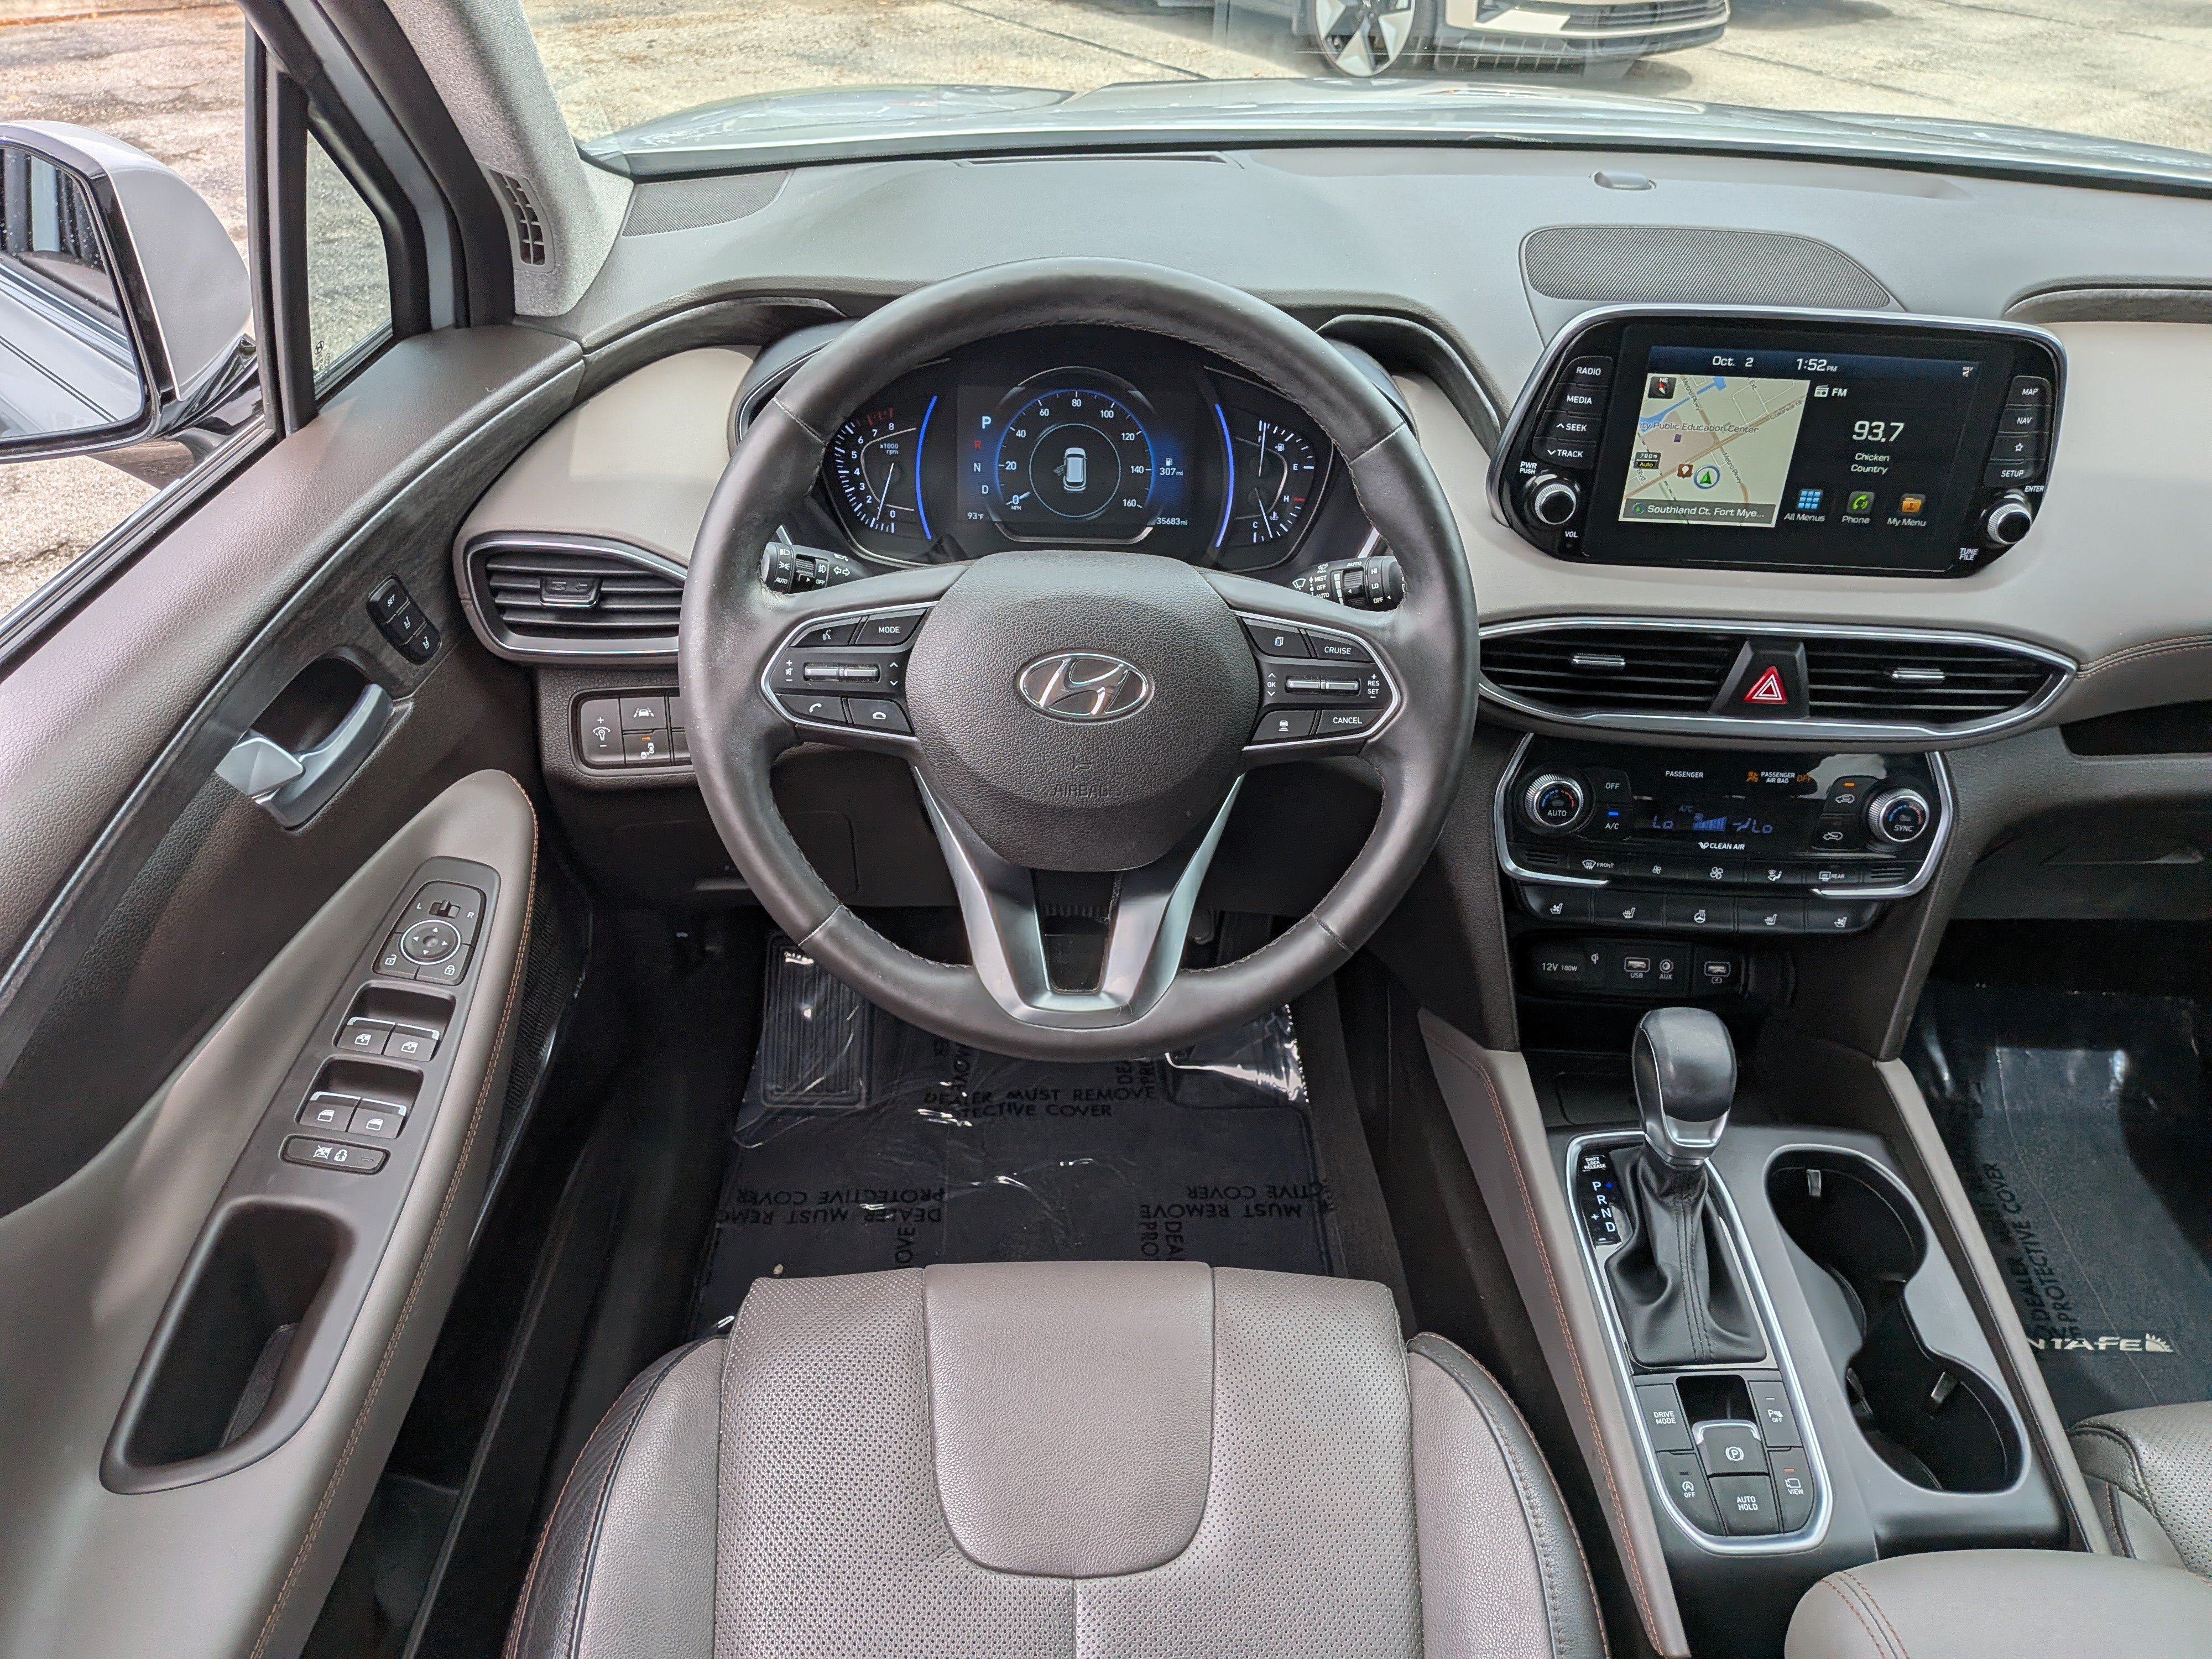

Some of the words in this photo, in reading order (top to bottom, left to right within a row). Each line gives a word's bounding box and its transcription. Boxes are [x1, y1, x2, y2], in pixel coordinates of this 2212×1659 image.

[1712, 356, 1735, 366] Oct.
[1745, 357, 1754, 367] 2
[1576, 367, 1601, 376] RADIO
[1832, 388, 1848, 397] FM
[1072, 399, 1082, 407] 80
[1566, 395, 1592, 404] MEDIA
[1039, 408, 1050, 416] 60
[1100, 410, 1114, 418] 100
[888, 422, 894, 431] 8
[982, 416, 992, 429] P
[1566, 423, 1587, 432] SEEK
[1682, 423, 1726, 432] Education
[1728, 425, 1759, 433] Center
[1852, 421, 1905, 442] 93.7
[872, 429, 878, 437] 7
[1015, 430, 1026, 438] 40
[1121, 432, 1135, 441] 120
[858, 436, 864, 444] 6
[974, 440, 981, 450] R
[851, 451, 857, 459] 5
[1557, 450, 1583, 458] TRACK
[1855, 452, 1890, 462] Chicken
[973, 462, 981, 472] N
[1005, 461, 1017, 470] 20
[1520, 461, 1537, 469] PWR
[1723, 452, 1734, 469] Metro
[1732, 469, 1743, 483] Pkwy
[1851, 464, 1888, 474] Country
[854, 468, 860, 476] 4
[1130, 466, 1144, 474] 140
[859, 482, 865, 491] 3
[982, 485, 989, 494] D
[866, 495, 872, 503] 2
[1012, 494, 1019, 504] 0
[1123, 499, 1136, 507] 160
[890, 510, 896, 518] 0
[1647, 505, 1697, 515] Southland
[1714, 508, 1735, 516] Fort
[1796, 514, 1825, 522] Menus
[1842, 515, 1870, 524] Phone
[1887, 518, 1901, 526] My
[1902, 519, 1927, 527] Menu
[775, 576, 788, 585] AUTO
[387, 594, 395, 607] SET
[878, 625, 900, 634] MODE
[1324, 646, 1352, 655] CRUISE
[1052, 784, 1110, 798] AIRBAG
[1678, 805, 1693, 813] A/C
[1542, 962, 1558, 971] 12V
[1006, 1089, 1061, 1102] MUST
[1073, 1087, 1156, 1102] REMOVE
[1046, 1104, 1113, 1118] COVER
[1592, 1181, 1601, 1191] P
[1983, 1162, 2022, 1215] COVER
[737, 1188, 808, 1205] COVER
[818, 1187, 946, 1204] PROTECTIVE
[1186, 1185, 1256, 1200] COVER
[1596, 1194, 1608, 1205] R
[1140, 1204, 1231, 1219] REMOVE
[1243, 1203, 1302, 1218] MUST
[1600, 1208, 1612, 1218] N
[786, 1208, 848, 1224] MUST
[1605, 1222, 1616, 1232] D
[2012, 1220, 2078, 1322] PROTECTIVE
[2026, 1336, 2143, 1351] NTAFE
